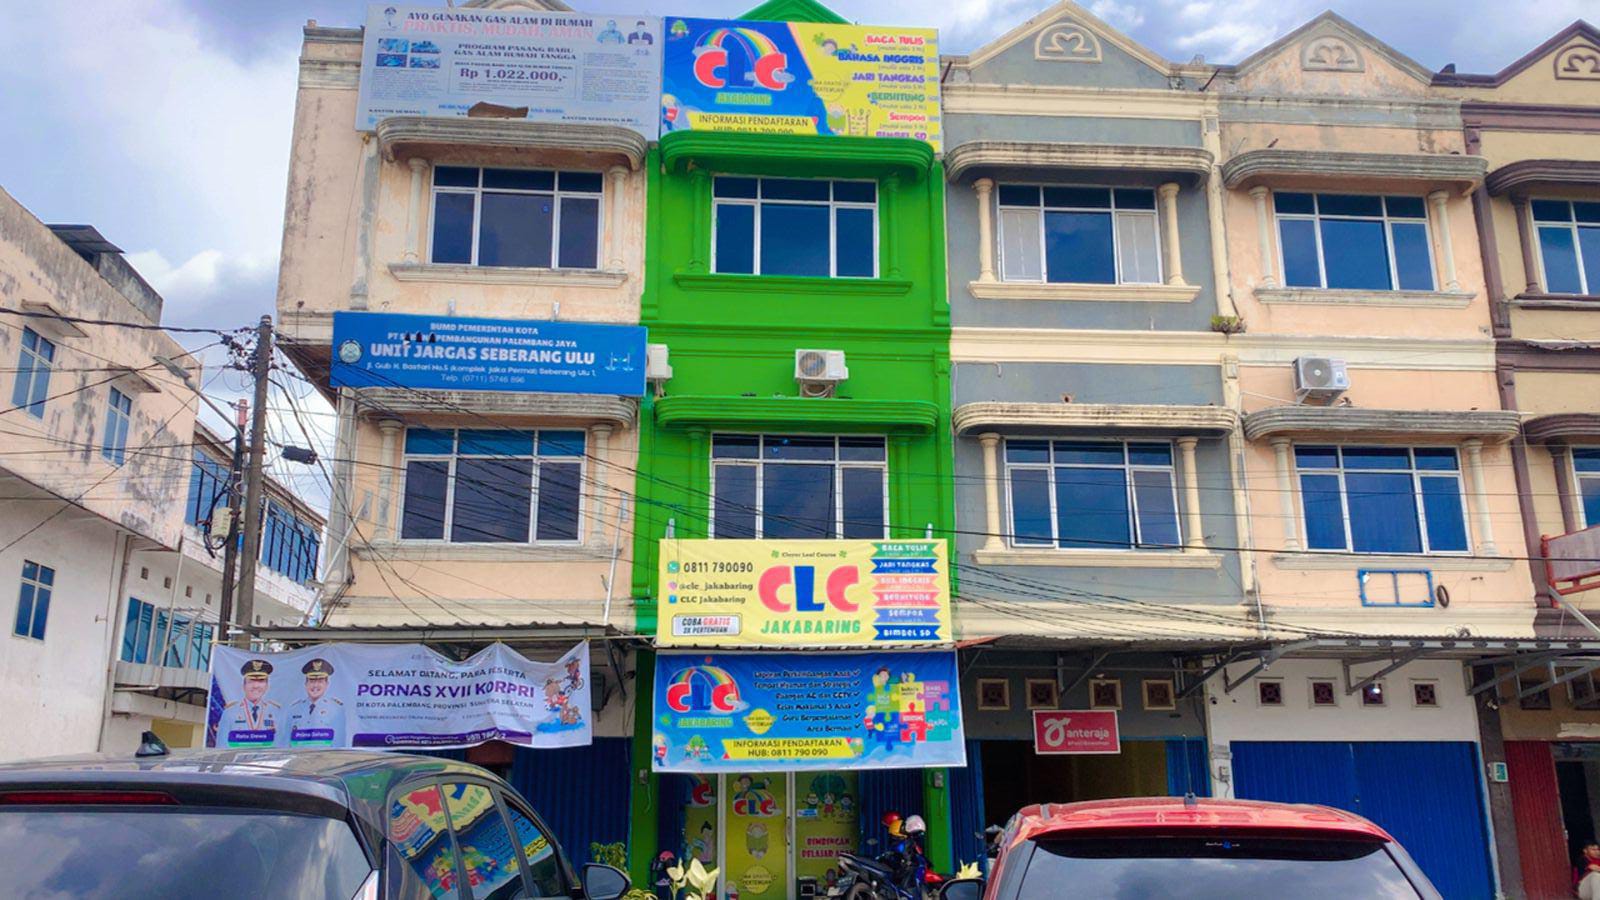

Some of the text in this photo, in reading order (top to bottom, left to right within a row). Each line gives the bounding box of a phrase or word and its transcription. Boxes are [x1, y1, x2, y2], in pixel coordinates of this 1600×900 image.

[408, 12, 593, 28] AYO GUNAKAN GAS ALAM DI RUMAH
[402, 20, 593, 39] PRAKTIS, MUDAH, AMAN
[866, 34, 896, 44] BACA
[899, 36, 924, 46] TULIS
[458, 43, 506, 51] PROGRAM
[541, 52, 576, 60] TANGGA
[838, 53, 880, 62] BAHASA
[883, 54, 924, 64] INGGRIS
[694, 36, 789, 90] CLC
[460, 68, 568, 82] Rp 1.022.000,-
[852, 72, 875, 81] JARI
[878, 73, 925, 83] TANGKAS
[870, 92, 926, 102] BERHITUNG
[698, 114, 808, 127] INFORMASI PENDAFTARAN
[889, 112, 926, 122] Sempoa
[914, 132, 927, 140] SD
[430, 322, 538, 335] BUMD PEMERINTAH KOTA
[388, 332, 398, 340] PT
[436, 334, 501, 344] PEMBANGUNAN
[502, 338, 554, 348] PALEMBANG
[370, 343, 596, 364] UNIT JARGAS SEBERANG ULU
[539, 368, 576, 378] Seberang
[683, 562, 754, 572] 0811 790090
[758, 565, 859, 612] CLC
[682, 618, 731, 626] COBA GRATIS
[760, 620, 861, 634] JAKABARING
[460, 669, 486, 679] PARA
[357, 680, 535, 698] PORNAS XVII KORPRI
[666, 673, 740, 712] CLC
[501, 698, 534, 709] SELATAN
[1066, 728, 1110, 740] anteraja
[782, 738, 842, 748] PENDAFTARAN
[734, 796, 774, 816] CLC
